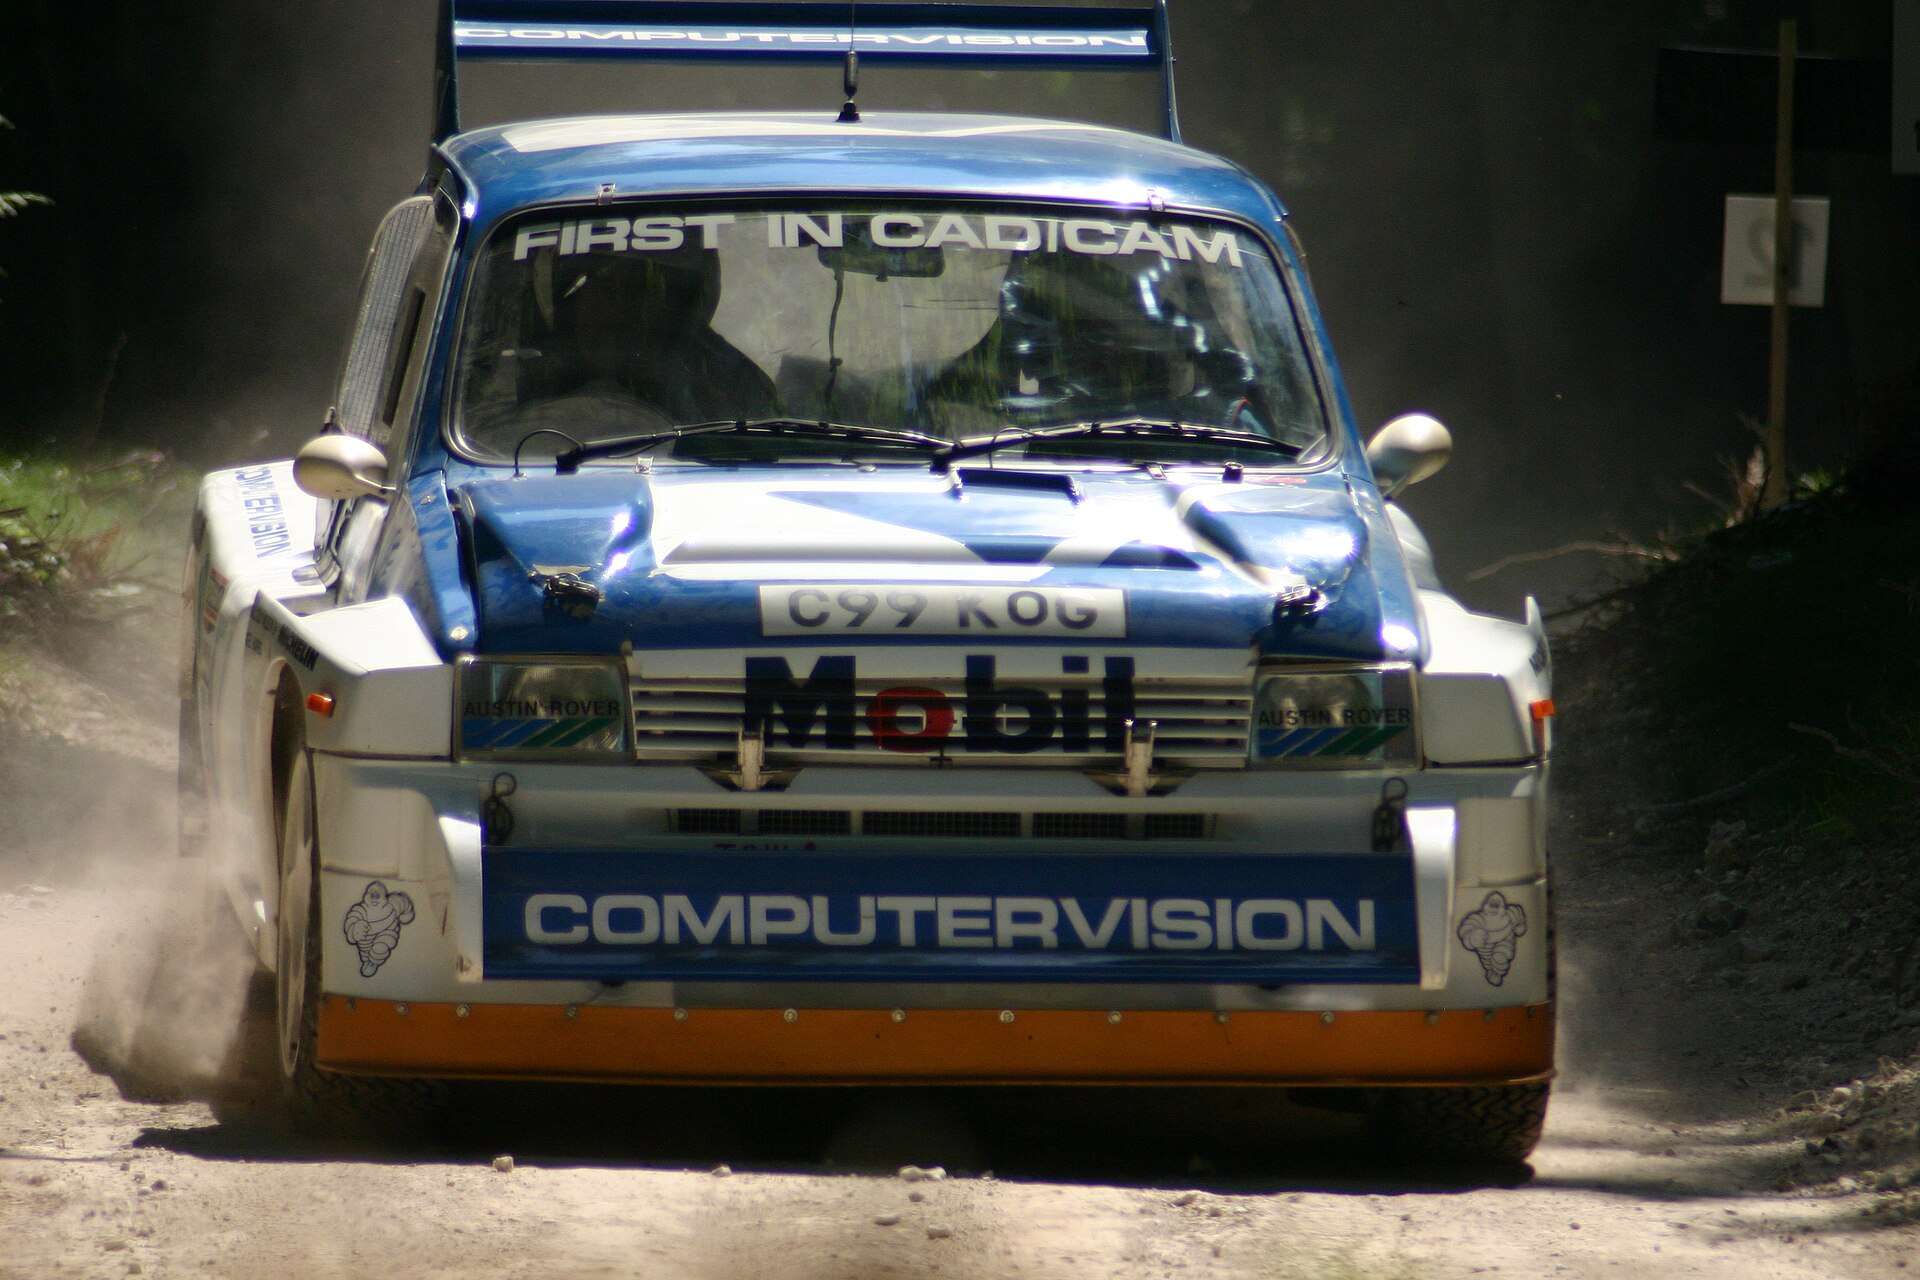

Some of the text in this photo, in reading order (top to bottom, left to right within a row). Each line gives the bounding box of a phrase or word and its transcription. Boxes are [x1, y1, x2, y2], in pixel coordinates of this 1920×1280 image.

[454, 28, 1149, 47] COMPUTERVISION
[514, 214, 735, 261] FIRST
[767, 212, 844, 249] IN
[787, 588, 1099, 630] C99 KOG
[463, 700, 620, 718] AUSTIN ROVER
[744, 655, 1136, 753] Mobil
[1257, 707, 1412, 727] AUSTIN ROVER
[524, 893, 1376, 951] COMPUTERVISION
